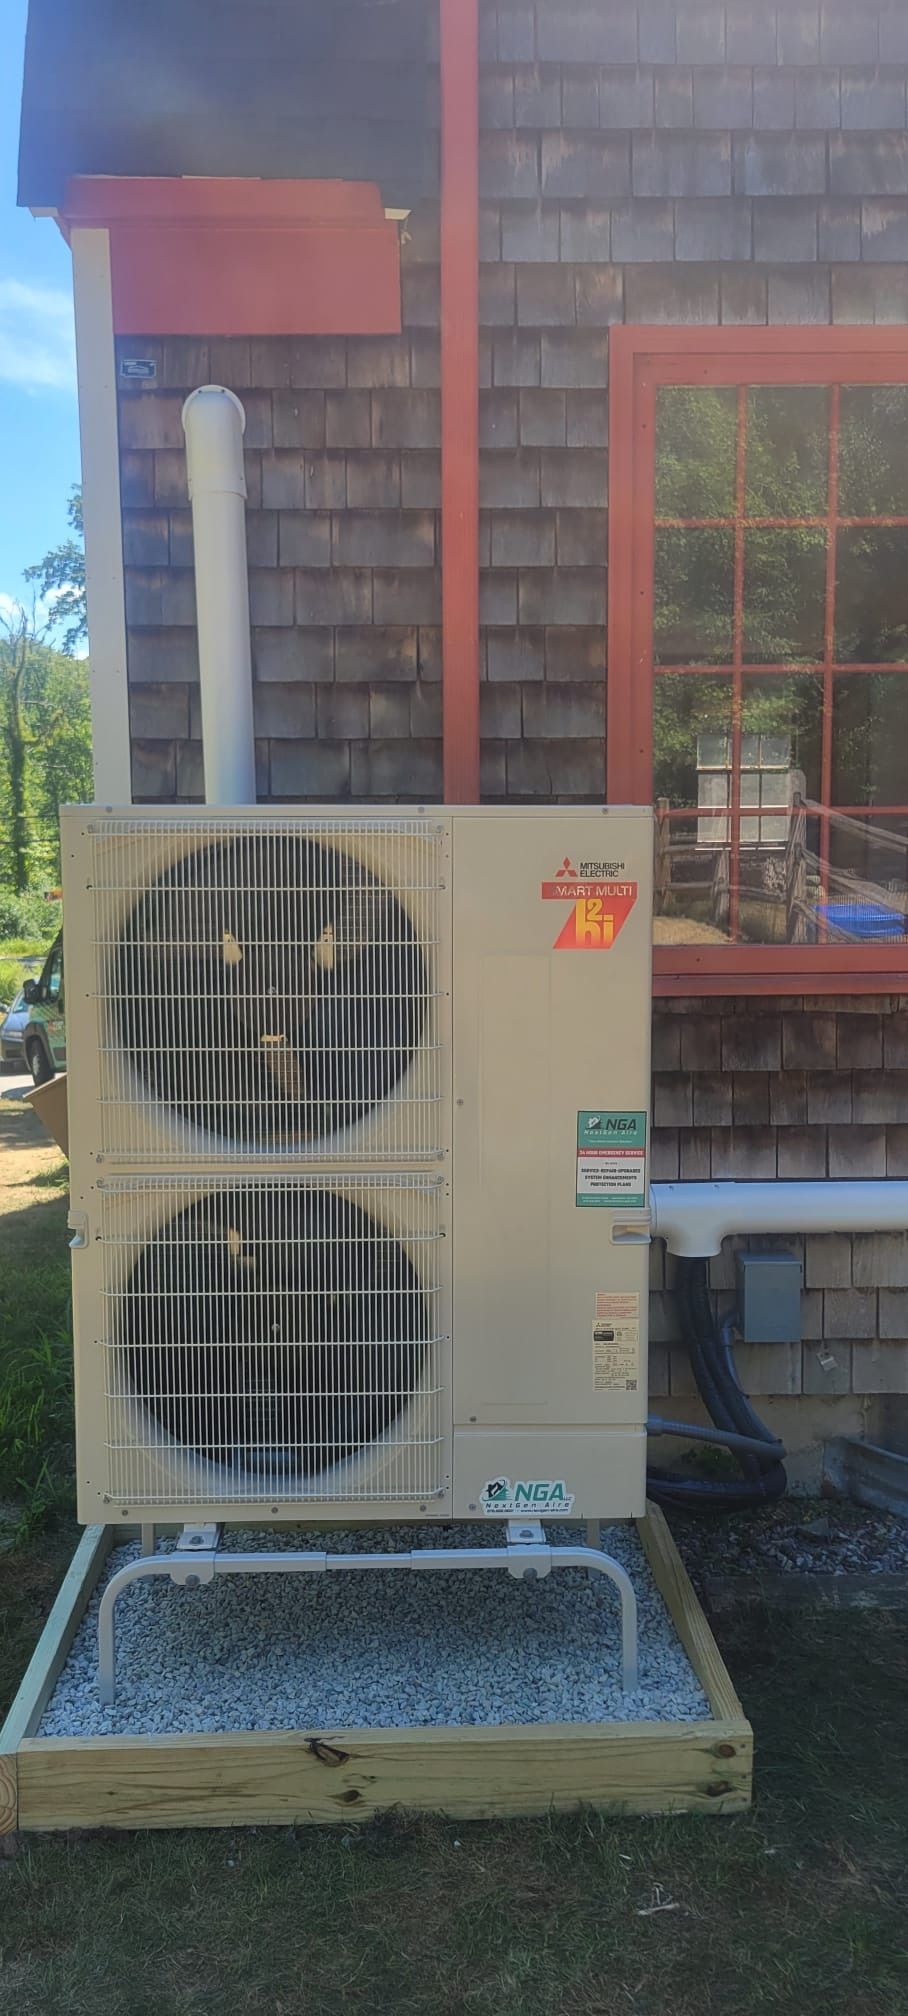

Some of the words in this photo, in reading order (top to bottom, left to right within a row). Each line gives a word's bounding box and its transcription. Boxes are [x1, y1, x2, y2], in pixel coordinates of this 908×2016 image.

[580, 862, 625, 870] MITSUBISHI
[596, 885, 632, 896] MULTI
[605, 1119, 637, 1130] NGA
[514, 1483, 564, 1501] NGA
